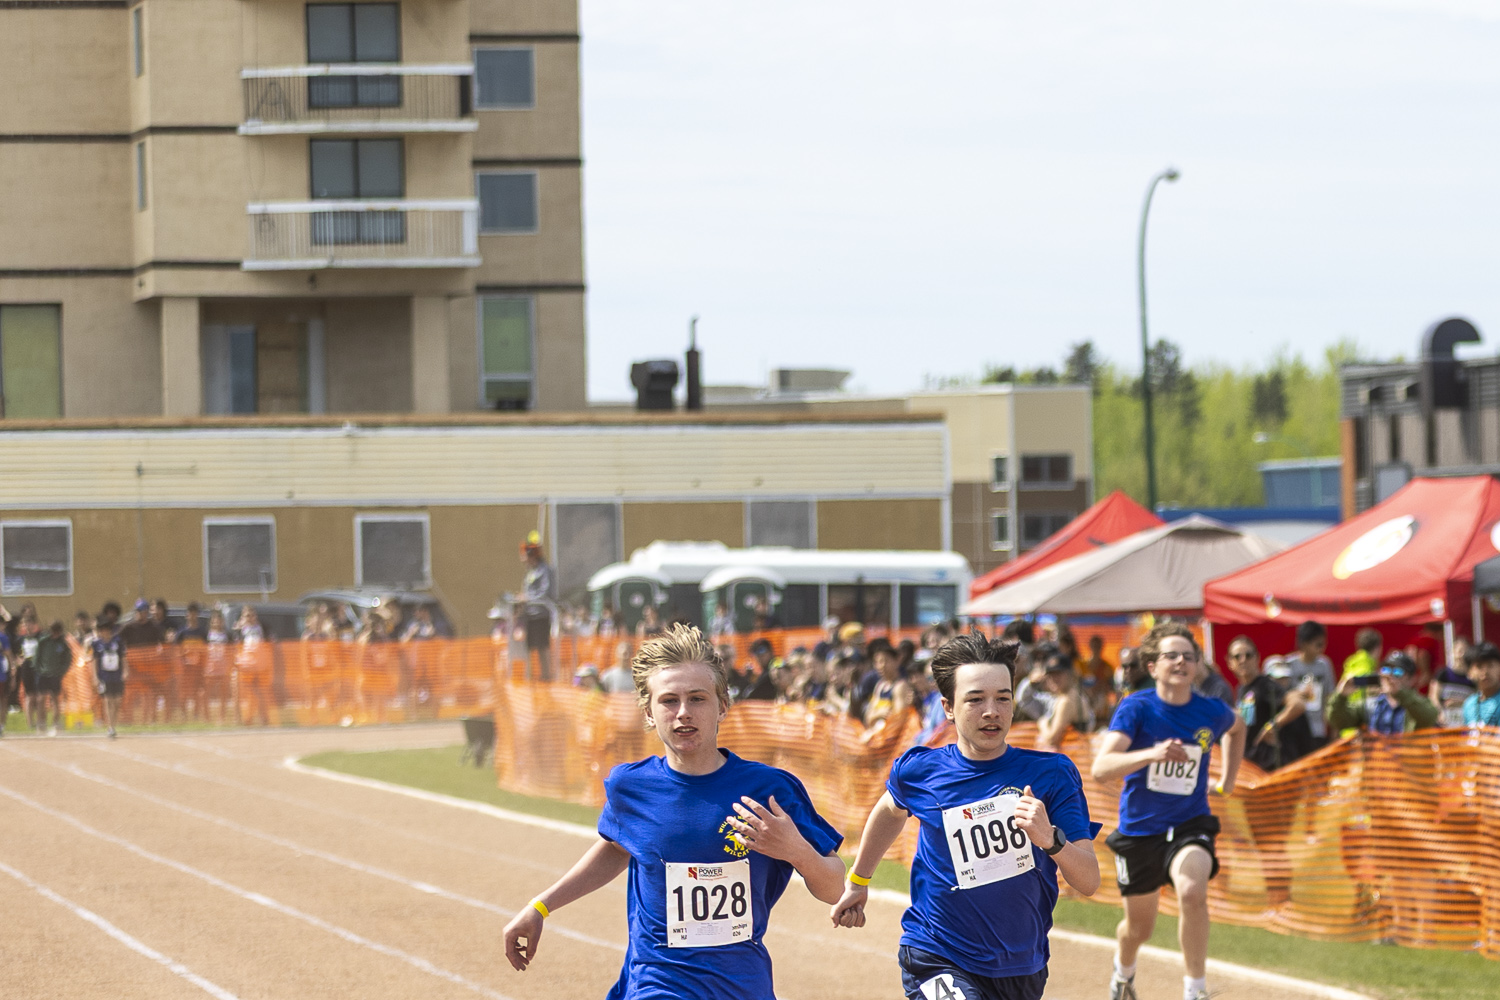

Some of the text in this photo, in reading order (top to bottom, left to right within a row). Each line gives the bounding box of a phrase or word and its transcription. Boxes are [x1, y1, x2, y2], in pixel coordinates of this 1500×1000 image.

[1156, 760, 1197, 779] 1082
[953, 815, 1027, 863] 1098
[673, 881, 747, 921] 1028
